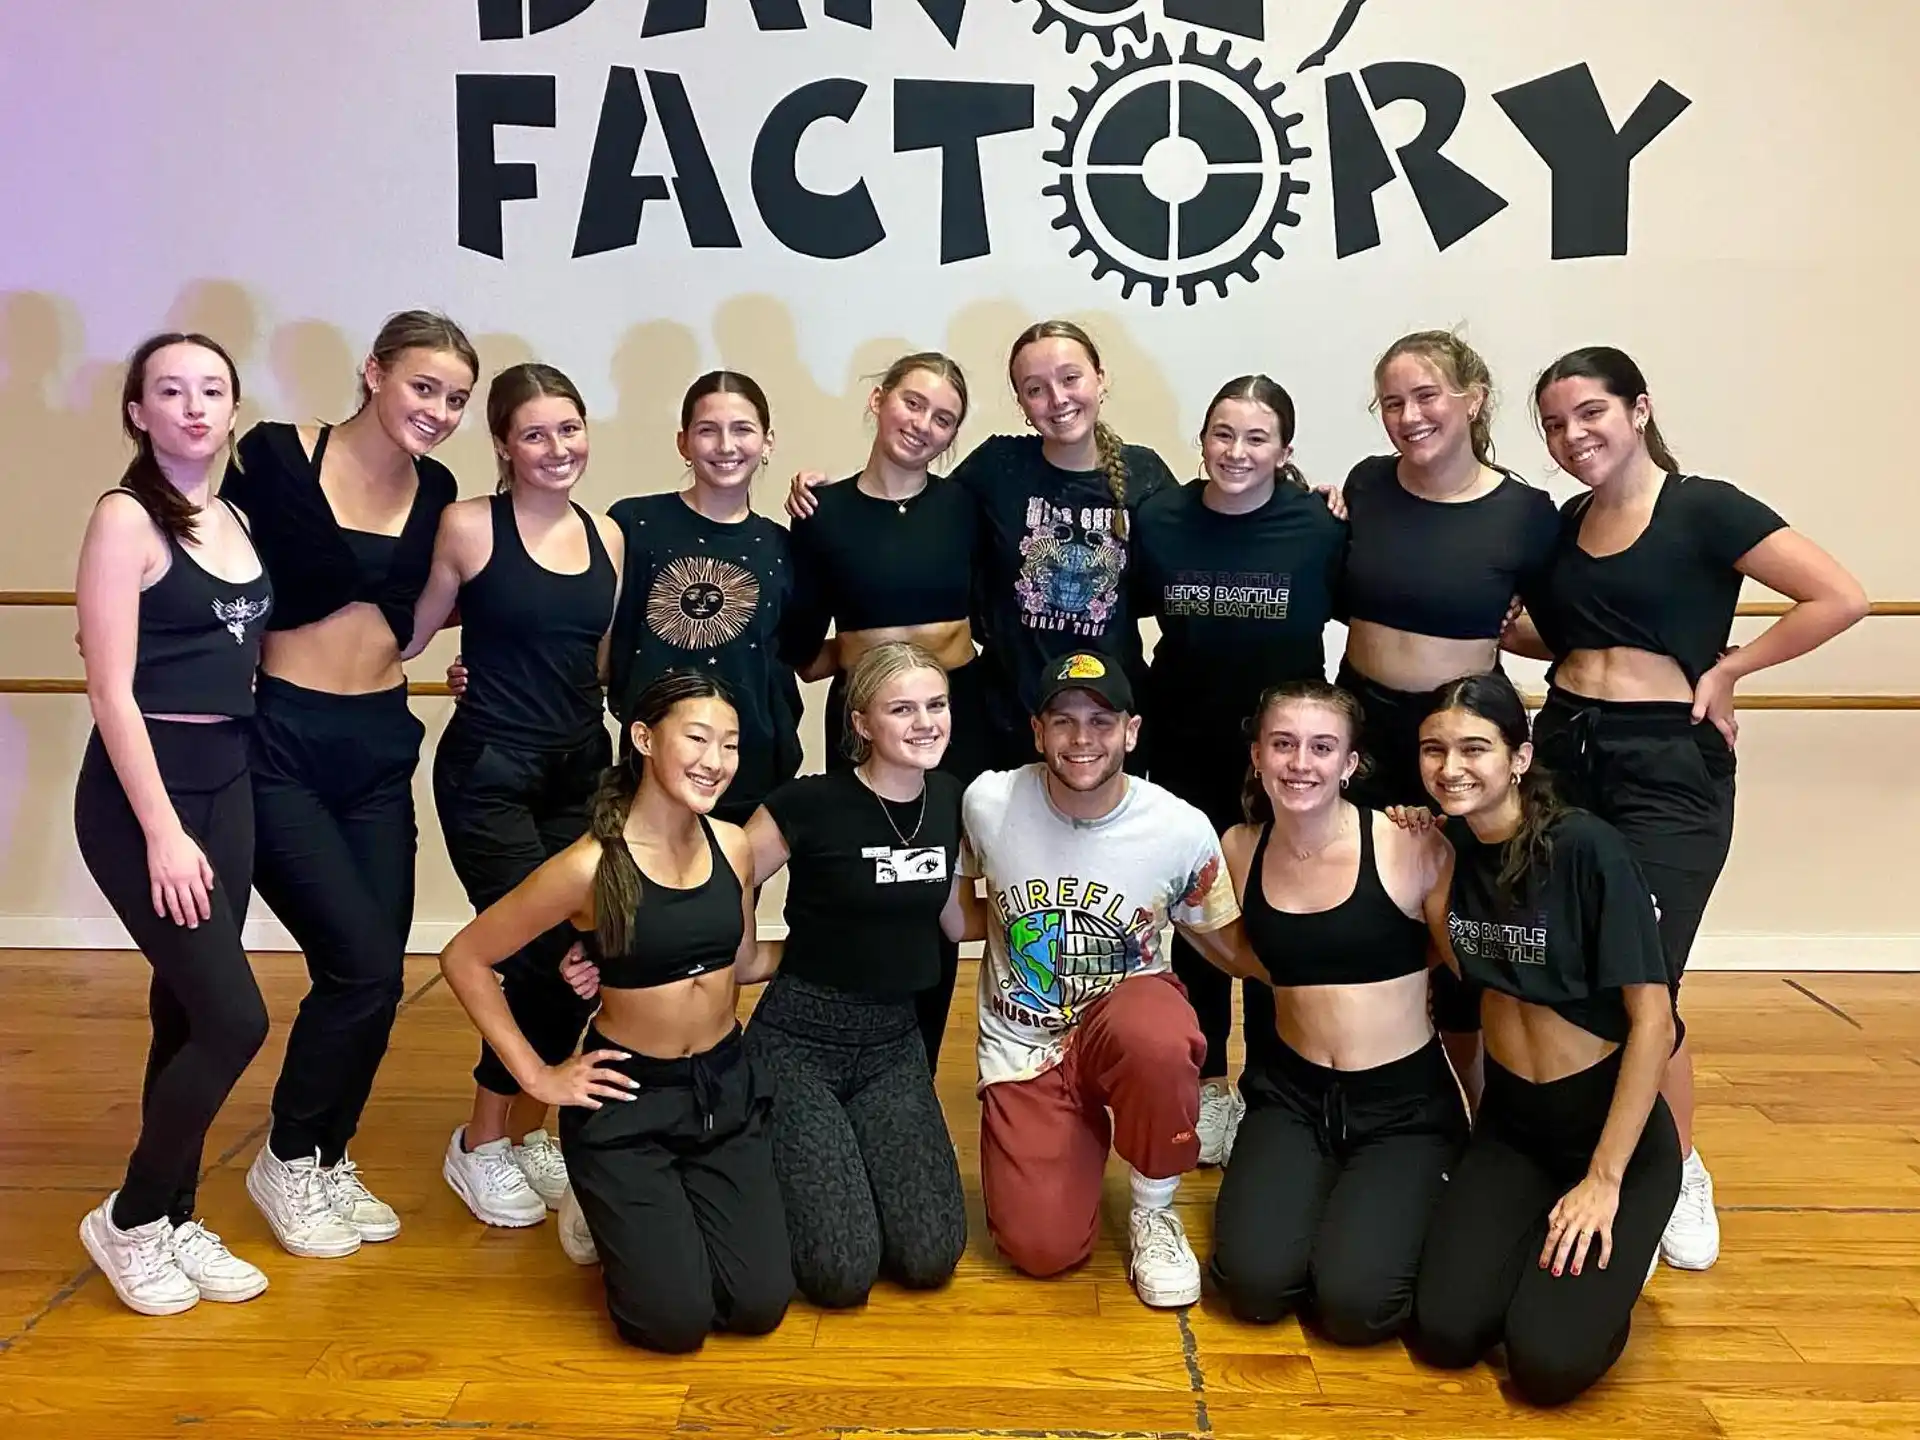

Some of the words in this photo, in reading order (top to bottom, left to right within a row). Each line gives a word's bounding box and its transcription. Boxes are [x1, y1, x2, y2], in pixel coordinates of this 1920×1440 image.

[456, 32, 1692, 306] FACTORY
[1164, 585, 1210, 601] LET'S
[1214, 586, 1290, 604] BATTLE
[1164, 600, 1210, 615] LET'S
[1213, 602, 1288, 619] BATTLE
[997, 877, 1150, 936] FIREFLY
[993, 995, 1060, 1029] MUSIC
